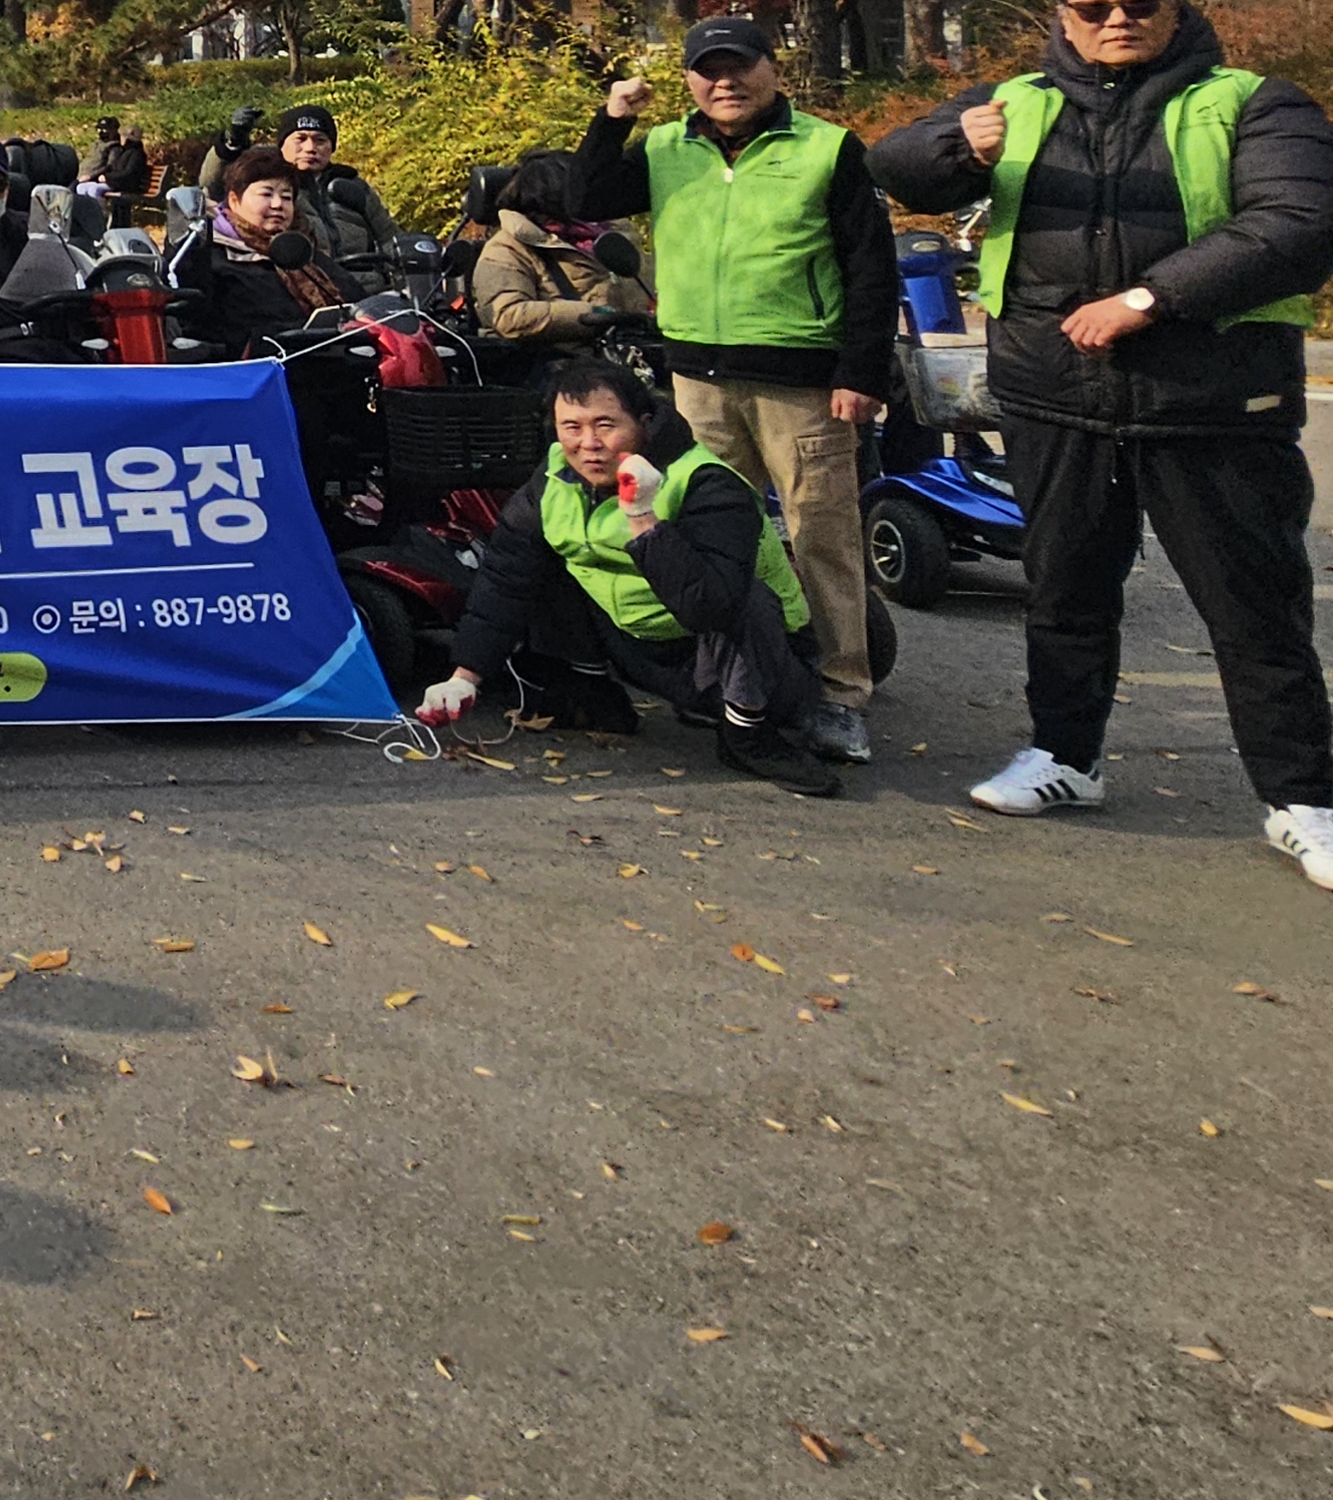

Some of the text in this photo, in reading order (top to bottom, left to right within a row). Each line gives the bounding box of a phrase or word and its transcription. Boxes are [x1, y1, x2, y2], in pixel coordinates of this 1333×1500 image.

[22, 445, 267, 547] 교육장
[70, 599, 125, 633] 문의
[153, 594, 290, 626] 887-9878
